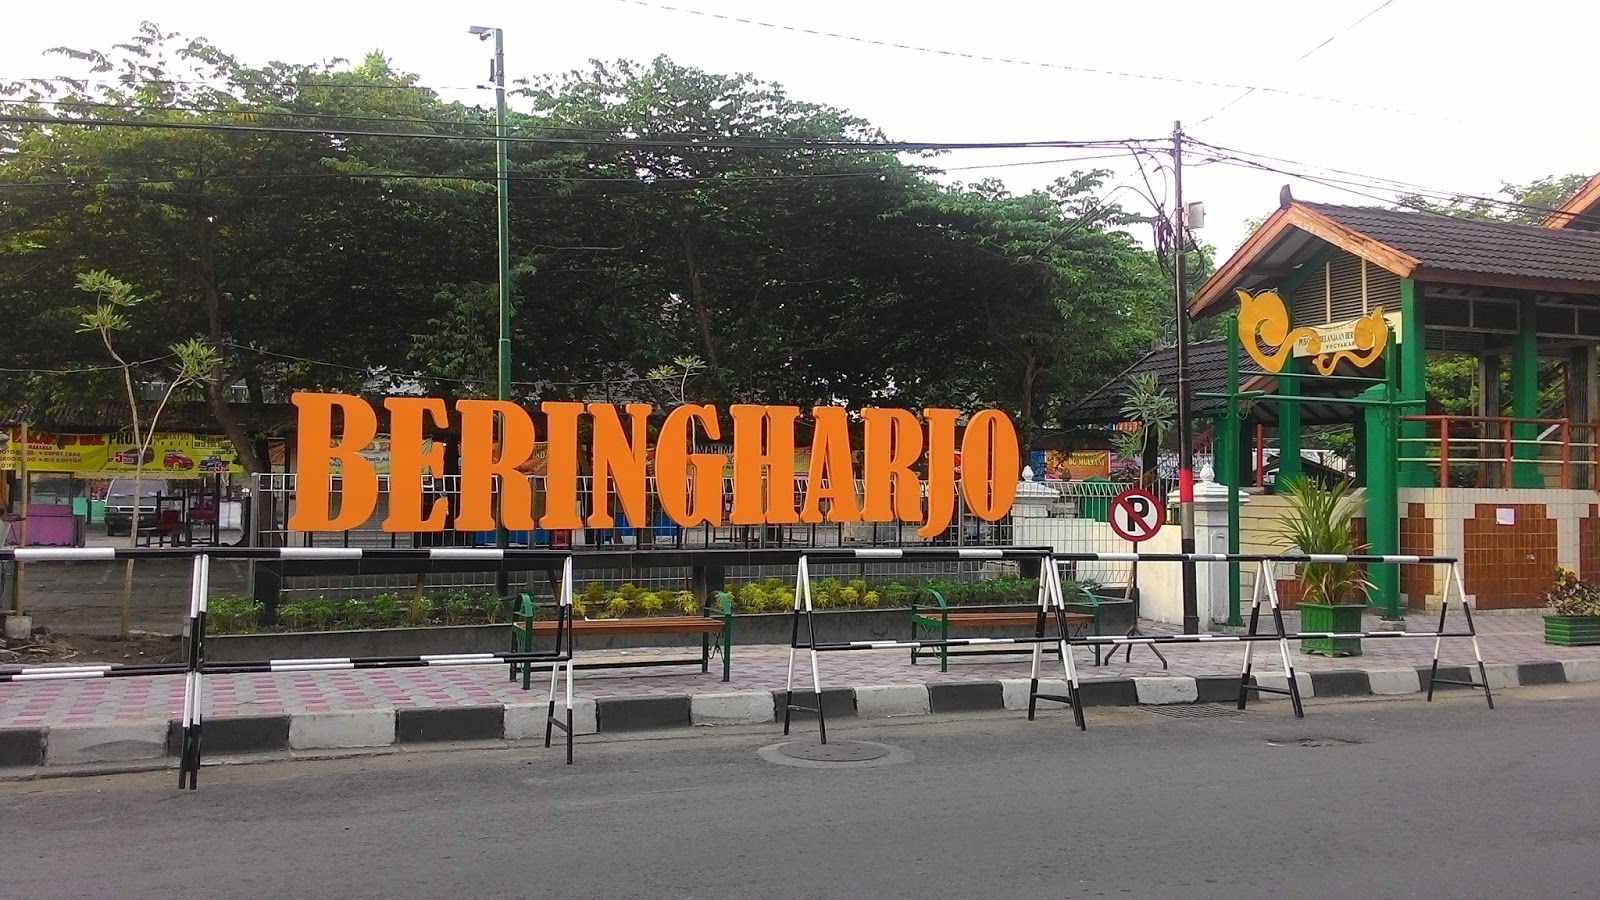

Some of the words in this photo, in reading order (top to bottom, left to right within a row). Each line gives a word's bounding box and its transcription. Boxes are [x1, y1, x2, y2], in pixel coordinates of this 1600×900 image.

[1325, 341, 1356, 349] YOGYAKAR
[288, 392, 1018, 538] BERINGHARJO
[1127, 498, 1149, 531] P
